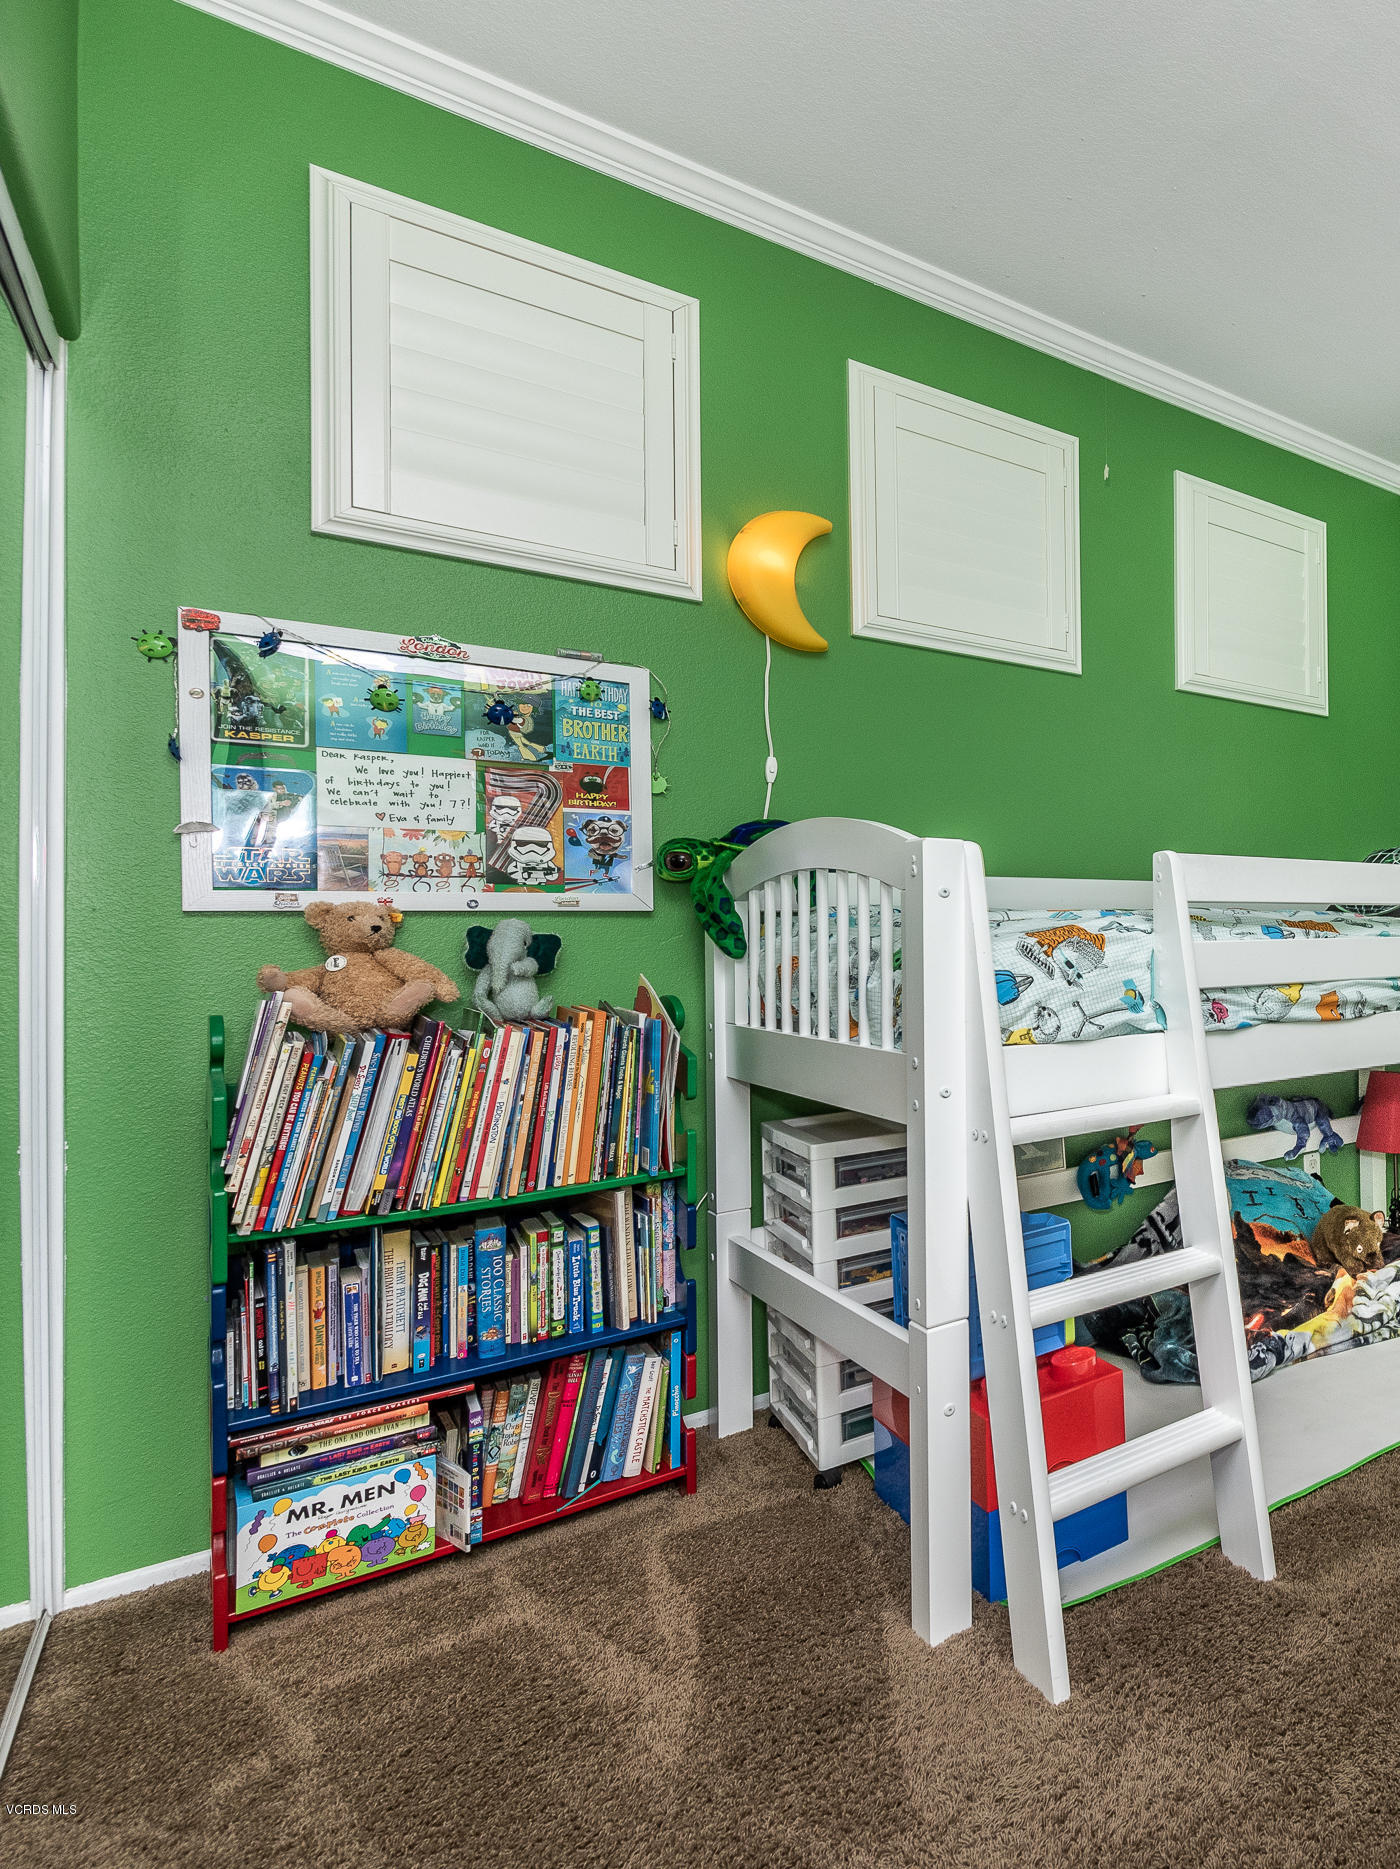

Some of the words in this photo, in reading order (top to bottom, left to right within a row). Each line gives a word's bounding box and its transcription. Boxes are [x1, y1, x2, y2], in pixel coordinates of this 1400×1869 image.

[400, 639, 469, 659] London
[571, 706, 594, 718] THE
[595, 709, 621, 721] BEST
[224, 730, 295, 742] KASPER
[255, 726, 301, 735] RESISTANCE
[562, 718, 629, 743] BROTHER
[321, 750, 347, 759] Dear
[353, 753, 394, 763] Kasper,
[573, 742, 618, 762] EARTH
[355, 766, 369, 774] We
[378, 767, 395, 775] love
[402, 767, 424, 778] you!
[431, 769, 472, 779] Happiest
[325, 776, 335, 784] of
[347, 777, 401, 789] birthdays
[429, 781, 451, 791] you!
[326, 788, 341, 796] We
[330, 798, 378, 806] celebrate
[419, 800, 442, 810] you!
[568, 799, 617, 808] BIRTHDAY!
[389, 814, 407, 822] Eva
[426, 814, 455, 826] family
[213, 847, 310, 864] STAR
[213, 867, 310, 883] WARS
[416, 1034, 432, 1072] CHILDREN'S
[568, 1034, 578, 1065] REVOLTING
[296, 1062, 309, 1090] PEANUTS
[306, 1066, 317, 1089] PEANUTS
[365, 1051, 380, 1085] SING-ALONG
[565, 1067, 573, 1090] RHYMES
[410, 1071, 422, 1097] WORLD
[278, 1095, 286, 1108] PECK
[292, 1090, 300, 1102] YOU
[349, 1092, 359, 1108] SLEEP
[397, 1094, 406, 1109] FIRST
[405, 1096, 416, 1117] ATLAS
[289, 1102, 298, 1114] CAN
[468, 1106, 476, 1118] Time
[269, 1112, 281, 1139] ARCHITECT
[488, 1100, 505, 1144] PADDINGTON
[332, 1159, 340, 1177] RANDOM
[380, 1154, 390, 1175] WORLD
[383, 1248, 393, 1264] THE
[492, 1255, 503, 1275] 100
[571, 1255, 580, 1277] Little
[396, 1260, 405, 1284] TERRY
[417, 1272, 429, 1287] DOG
[384, 1267, 393, 1313] BROMELIAD
[417, 1287, 428, 1301] MAN
[479, 1267, 491, 1312] STORIES
[572, 1278, 580, 1295] Blue
[395, 1287, 405, 1333] PRATCHETT
[492, 1279, 503, 1321] CLASSIC
[572, 1295, 580, 1320] Truck
[315, 1325, 324, 1346] DANNY
[384, 1315, 393, 1349] TRILOGY
[256, 1339, 264, 1348] and
[529, 1382, 538, 1405] STUART
[293, 1422, 315, 1432] STAR
[316, 1417, 335, 1426] WARS
[338, 1413, 351, 1421] THE
[355, 1406, 381, 1416] FORCE
[636, 1395, 650, 1436] MATCHSTICK
[246, 1433, 323, 1457] HORIZON
[318, 1438, 333, 1448] THE
[333, 1434, 348, 1444] ONE
[349, 1430, 364, 1440] AND
[364, 1426, 382, 1437] ONLY
[382, 1421, 399, 1432] IVAN
[328, 1450, 346, 1460] LAST
[346, 1446, 362, 1455] KIDS
[369, 1438, 390, 1449] EARTH
[631, 1437, 643, 1464] CASTLE
[319, 1474, 333, 1482] THE
[333, 1469, 351, 1478] LAST
[351, 1464, 368, 1473] KIDS
[379, 1456, 400, 1466] EARTH
[287, 1497, 335, 1525] MR.
[340, 1480, 396, 1510] MEN
[285, 1529, 302, 1540] The
[303, 1513, 355, 1536] Complete
[356, 1503, 394, 1519] Collection
